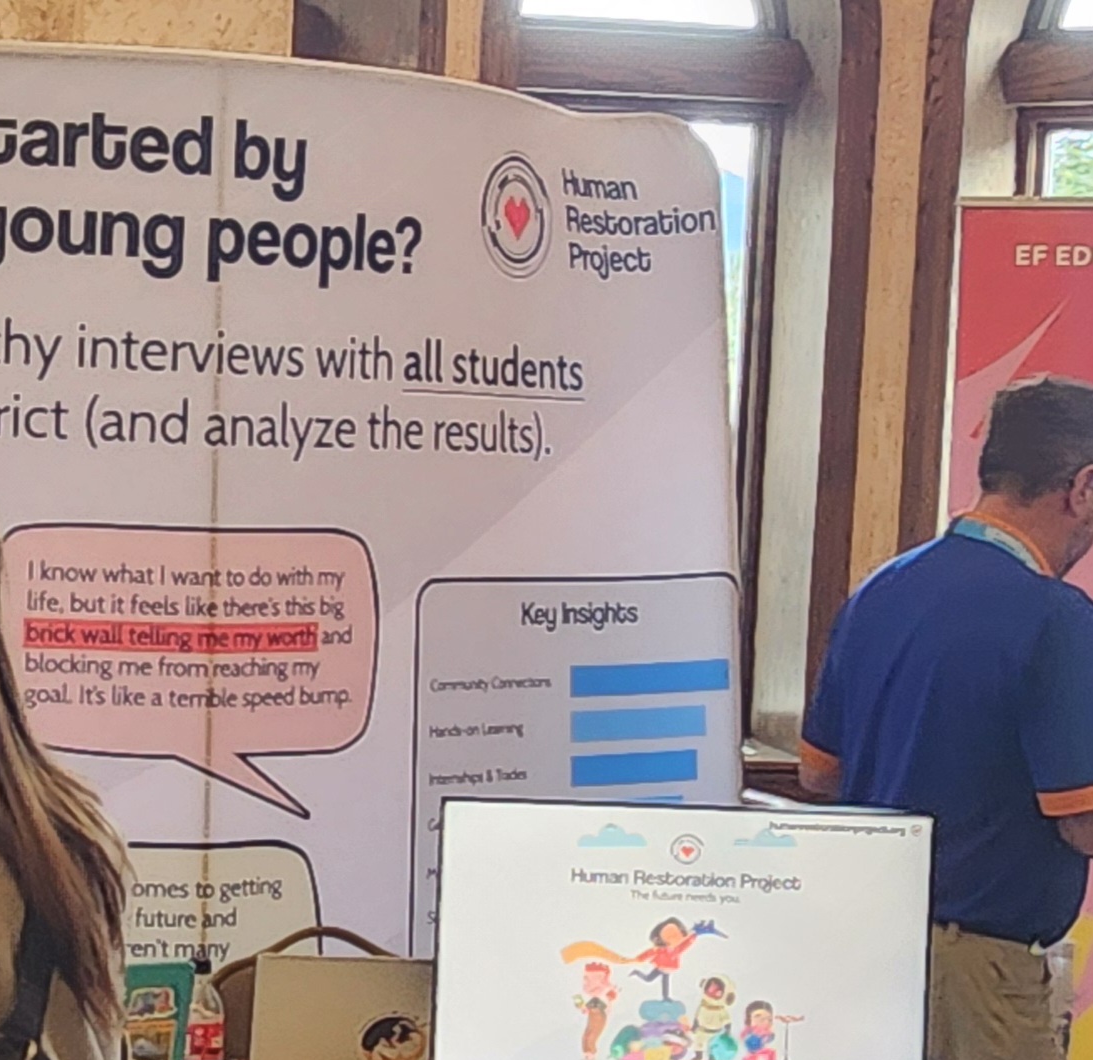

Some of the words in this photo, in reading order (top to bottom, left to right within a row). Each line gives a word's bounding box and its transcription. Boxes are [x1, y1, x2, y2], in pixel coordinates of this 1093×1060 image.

[235, 119, 307, 201] by
[562, 167, 637, 200] Human
[566, 205, 716, 236] Restoration
[207, 213, 422, 288] people?
[569, 242, 651, 280] Project
[1015, 244, 1048, 266] EF
[78, 324, 304, 379] interviews
[316, 335, 393, 382] with
[403, 339, 442, 383] all
[452, 344, 583, 392] students
[85, 394, 188, 450] (and
[206, 403, 356, 461] analyze
[367, 405, 423, 451] the
[434, 410, 551, 462] results).
[28, 560, 34, 581] I
[40, 561, 96, 583] know
[102, 563, 153, 585] what
[160, 565, 166, 585] I
[171, 569, 221, 587] want
[226, 570, 244, 587] to
[248, 566, 272, 587] do
[277, 566, 313, 587] with
[317, 571, 345, 590] my
[26, 590, 64, 615] life,
[70, 592, 105, 614] but
[110, 594, 124, 614] it
[130, 594, 179, 616] feels
[185, 595, 218, 617] like
[223, 597, 280, 618] there's
[285, 597, 315, 617] this
[319, 597, 344, 620] big
[521, 602, 557, 632] Key
[562, 602, 638, 630] Insights
[25, 620, 75, 642] brick
[81, 622, 124, 644] wall
[129, 625, 192, 651] telling
[198, 630, 229, 648] me
[233, 631, 263, 652] my
[267, 626, 317, 647] worth
[321, 625, 352, 646] and
[25, 653, 112, 681] blocking
[118, 659, 152, 677] me
[159, 656, 208, 678] from
[212, 657, 288, 683] reaching
[292, 660, 320, 683] my
[24, 683, 72, 708] goal.
[80, 684, 106, 705] It's
[112, 685, 145, 706] like
[151, 690, 162, 706] a
[169, 688, 237, 708] terrible
[241, 686, 295, 713] speed
[299, 686, 353, 709] bump.
[131, 881, 188, 899] omes
[195, 880, 214, 898] to
[219, 876, 283, 903] getting
[571, 867, 629, 885] Human
[634, 869, 736, 888] Restoration
[740, 873, 801, 893] Project
[631, 890, 650, 899] The
[652, 890, 683, 901] future
[685, 893, 717, 903] needs
[135, 907, 196, 928] future
[202, 908, 237, 927] and
[174, 943, 230, 962] many
